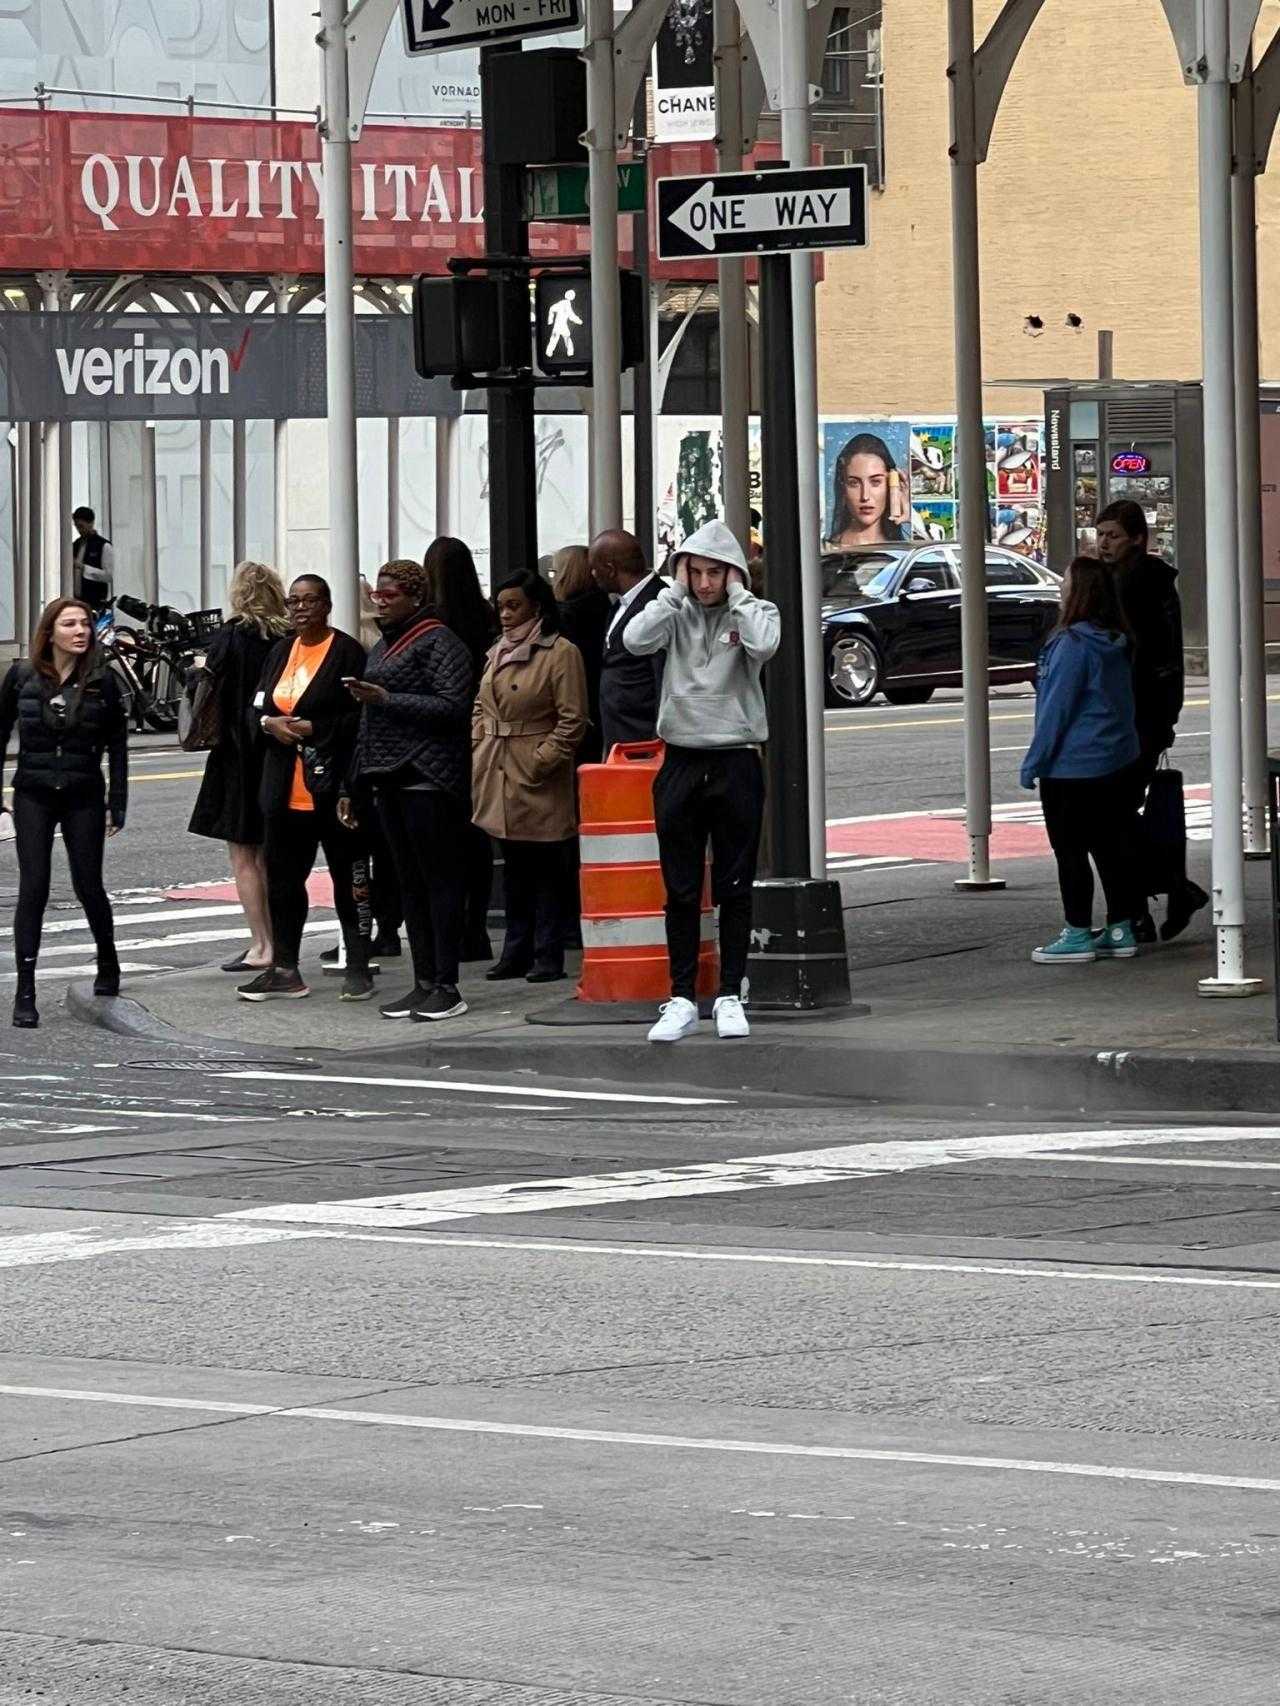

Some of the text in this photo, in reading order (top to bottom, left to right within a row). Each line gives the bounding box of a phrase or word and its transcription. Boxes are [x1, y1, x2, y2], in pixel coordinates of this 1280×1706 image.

[476, 3, 515, 26] MON
[432, 85, 480, 97] VORNAD
[658, 96, 715, 114] CHANE
[359, 163, 484, 223] ITAL
[689, 192, 838, 231] ONE WAY
[55, 333, 230, 395] verizon
[1112, 456, 1146, 470] OPEN
